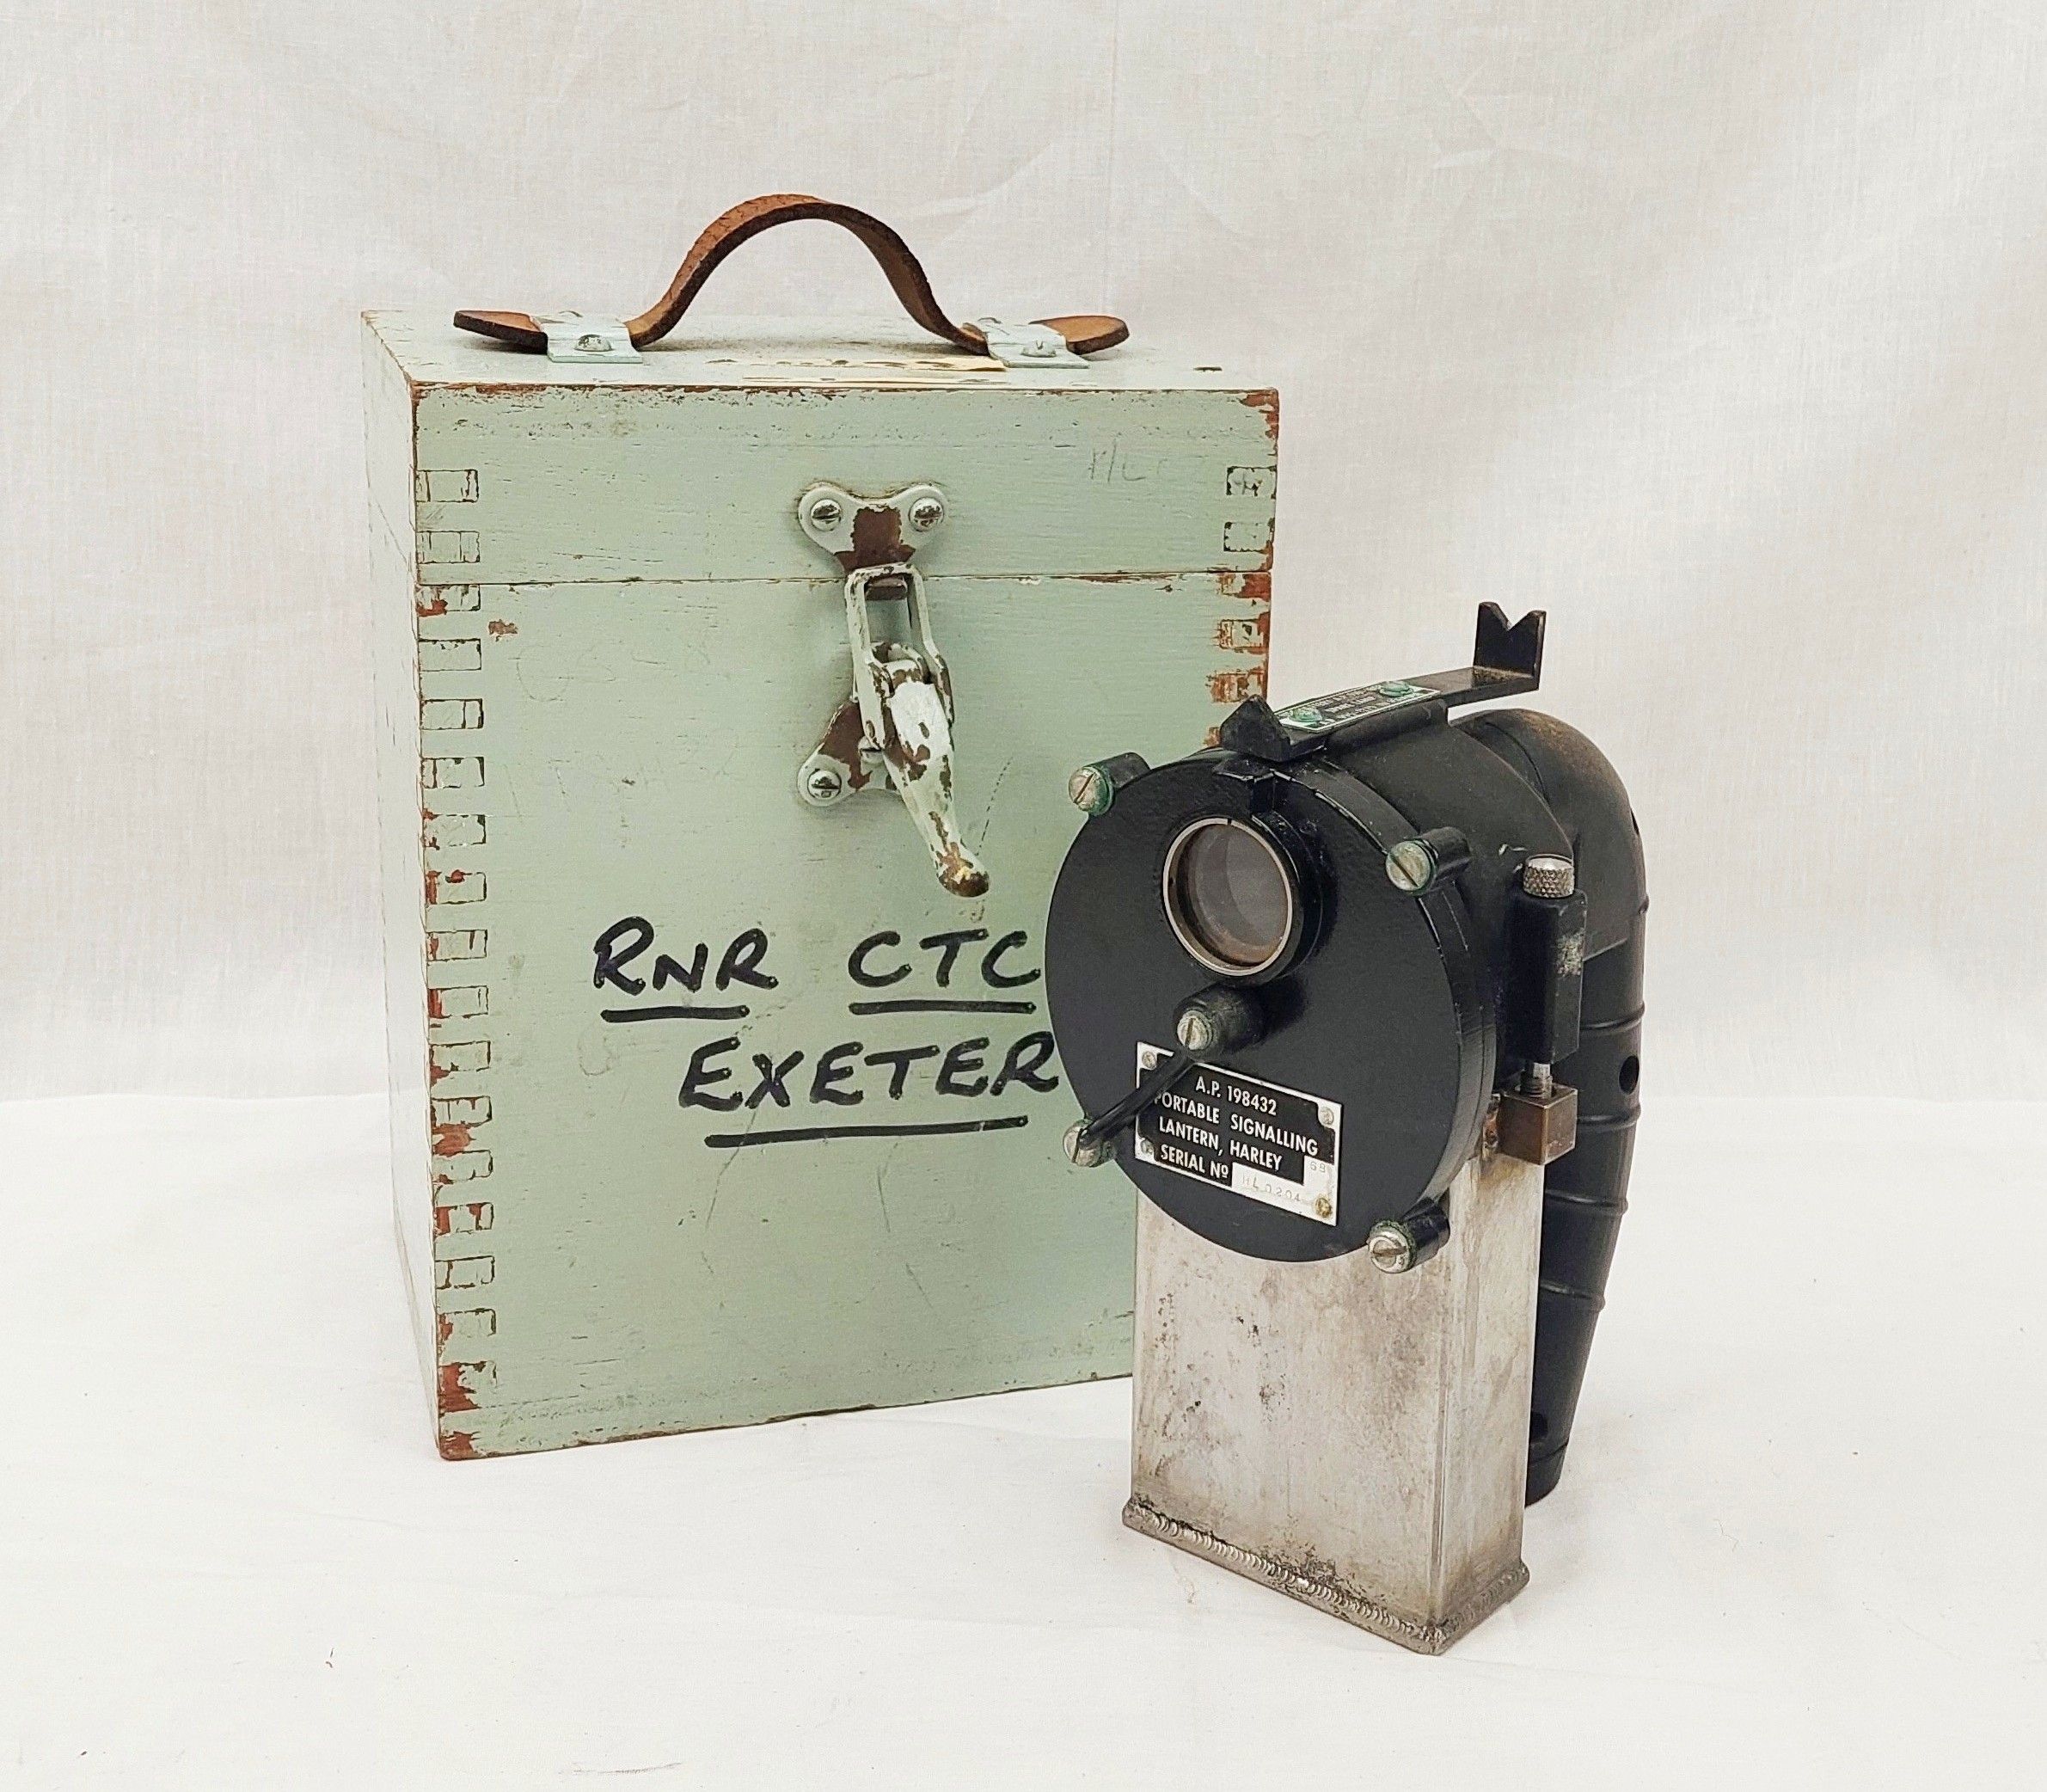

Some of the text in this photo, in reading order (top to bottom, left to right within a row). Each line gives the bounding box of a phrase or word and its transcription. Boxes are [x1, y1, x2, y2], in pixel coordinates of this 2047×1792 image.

[593, 916, 1041, 995] RNR CTC
[678, 1031, 1059, 1112] EXETER
[1195, 1076, 1277, 1116] A.P. 198432
[1159, 1116, 1283, 1171] LANTERN, HARLEY
[1161, 1145, 1205, 1173] SERIAL
[1230, 1114, 1318, 1156] SIGNALLING
